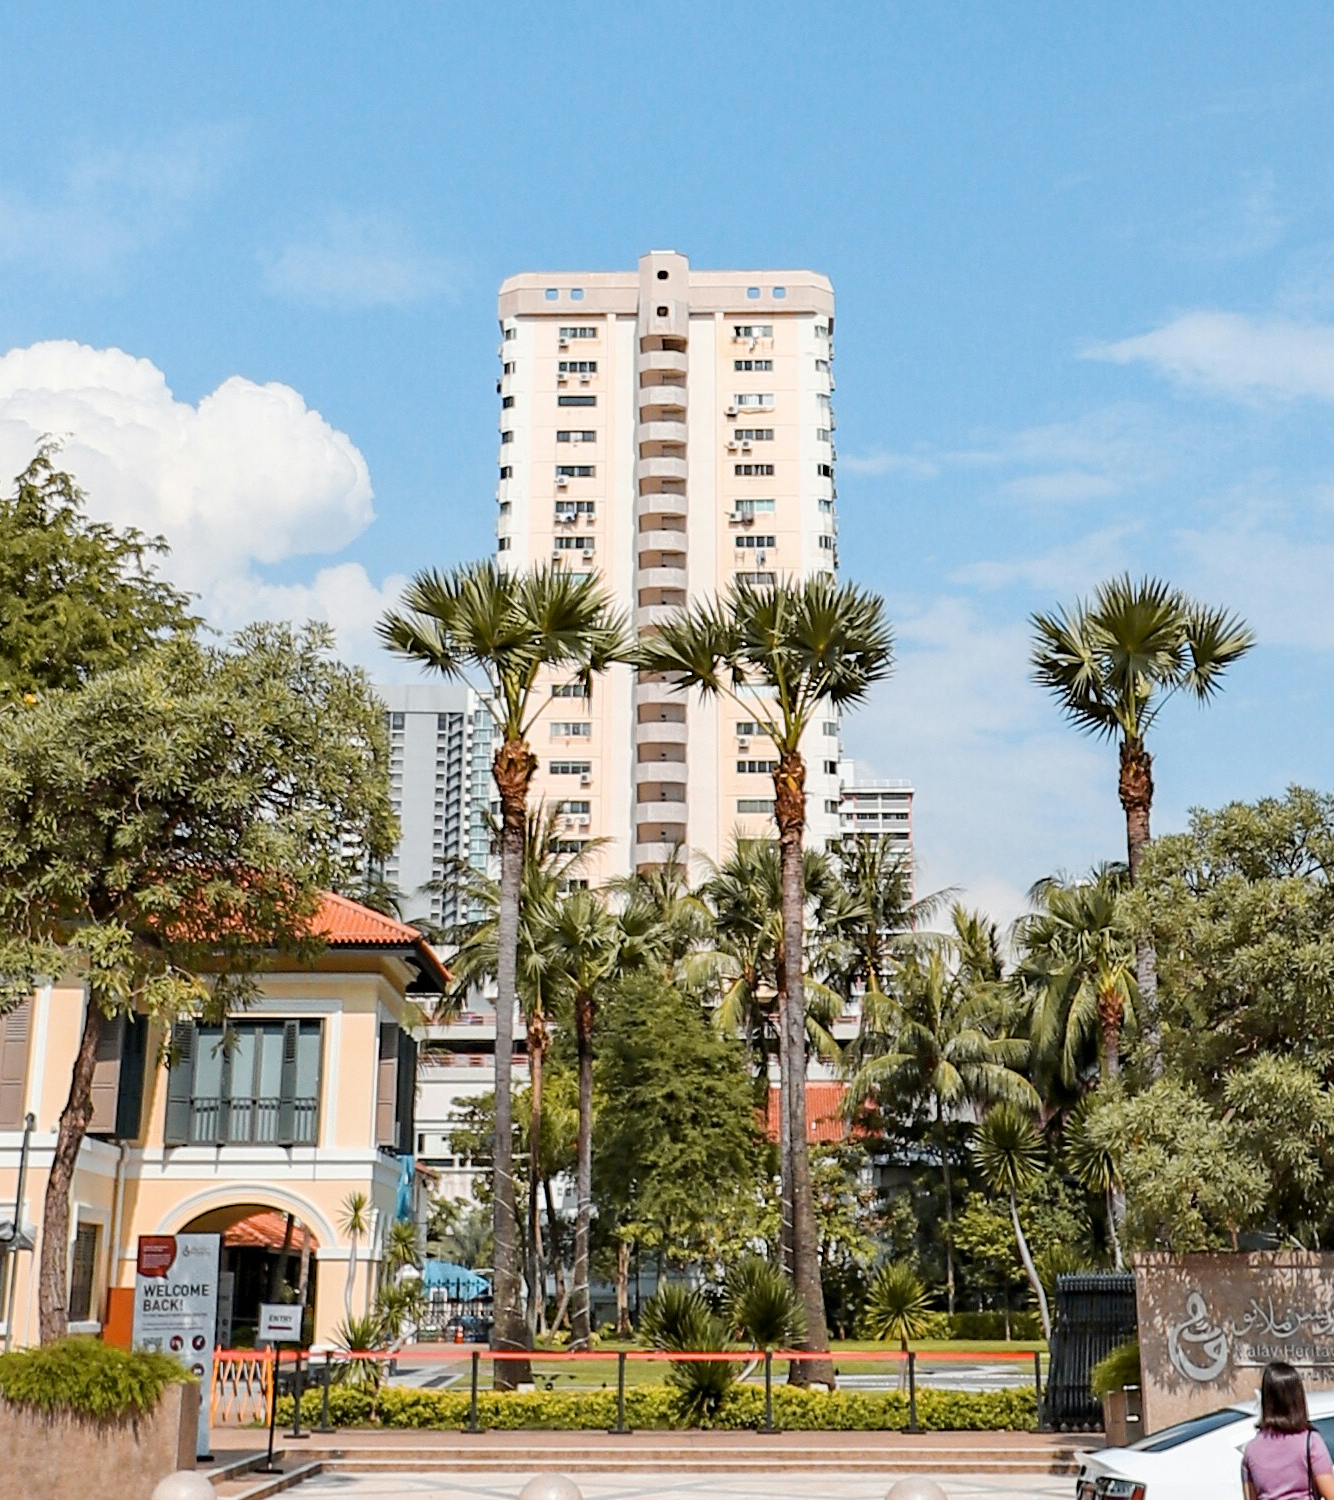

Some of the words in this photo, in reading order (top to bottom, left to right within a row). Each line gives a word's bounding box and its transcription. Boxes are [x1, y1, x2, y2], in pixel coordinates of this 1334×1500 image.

[144, 1284, 210, 1298] WELCOME
[143, 1299, 184, 1312] BACK!
[269, 1314, 293, 1323] ENTRY
[1234, 1343, 1279, 1361] Malay
